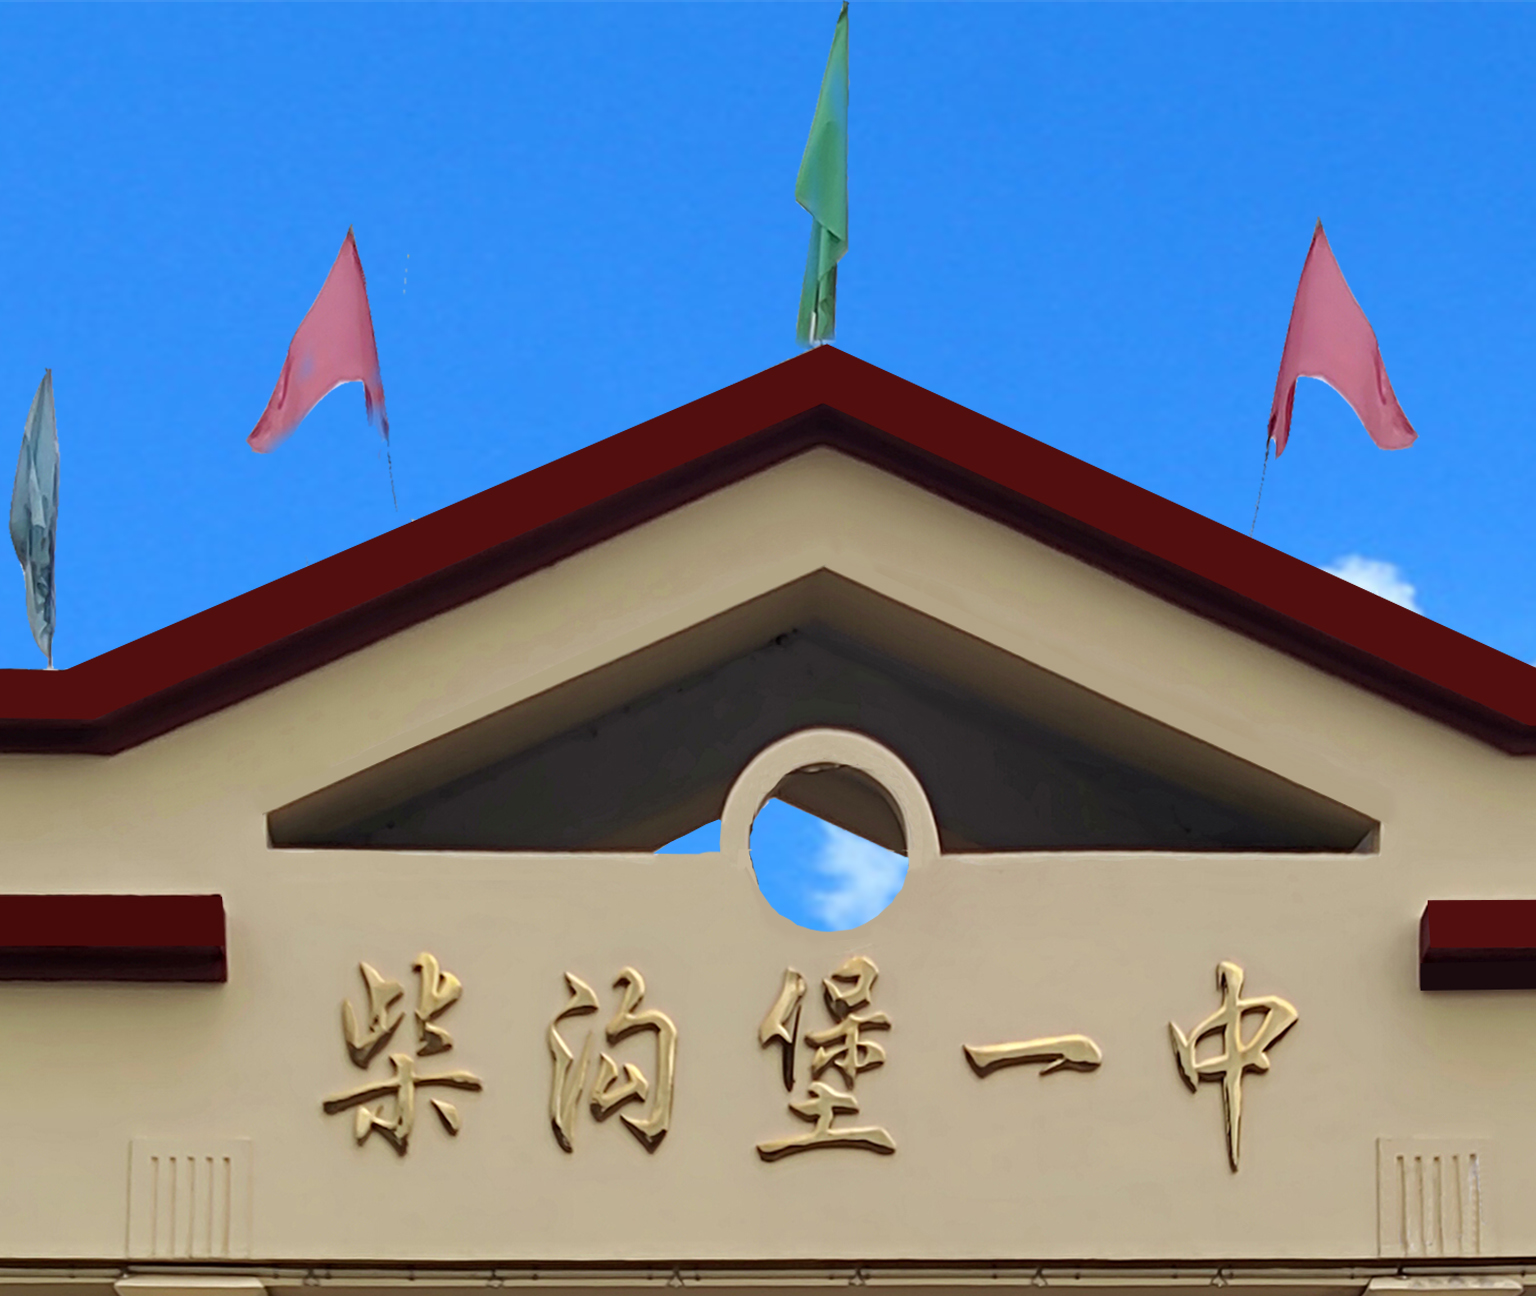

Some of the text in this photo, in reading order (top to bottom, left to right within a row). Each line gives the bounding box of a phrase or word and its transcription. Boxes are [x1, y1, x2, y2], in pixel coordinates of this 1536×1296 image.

[322, 951, 1298, 1173] 柴沟堡一中
